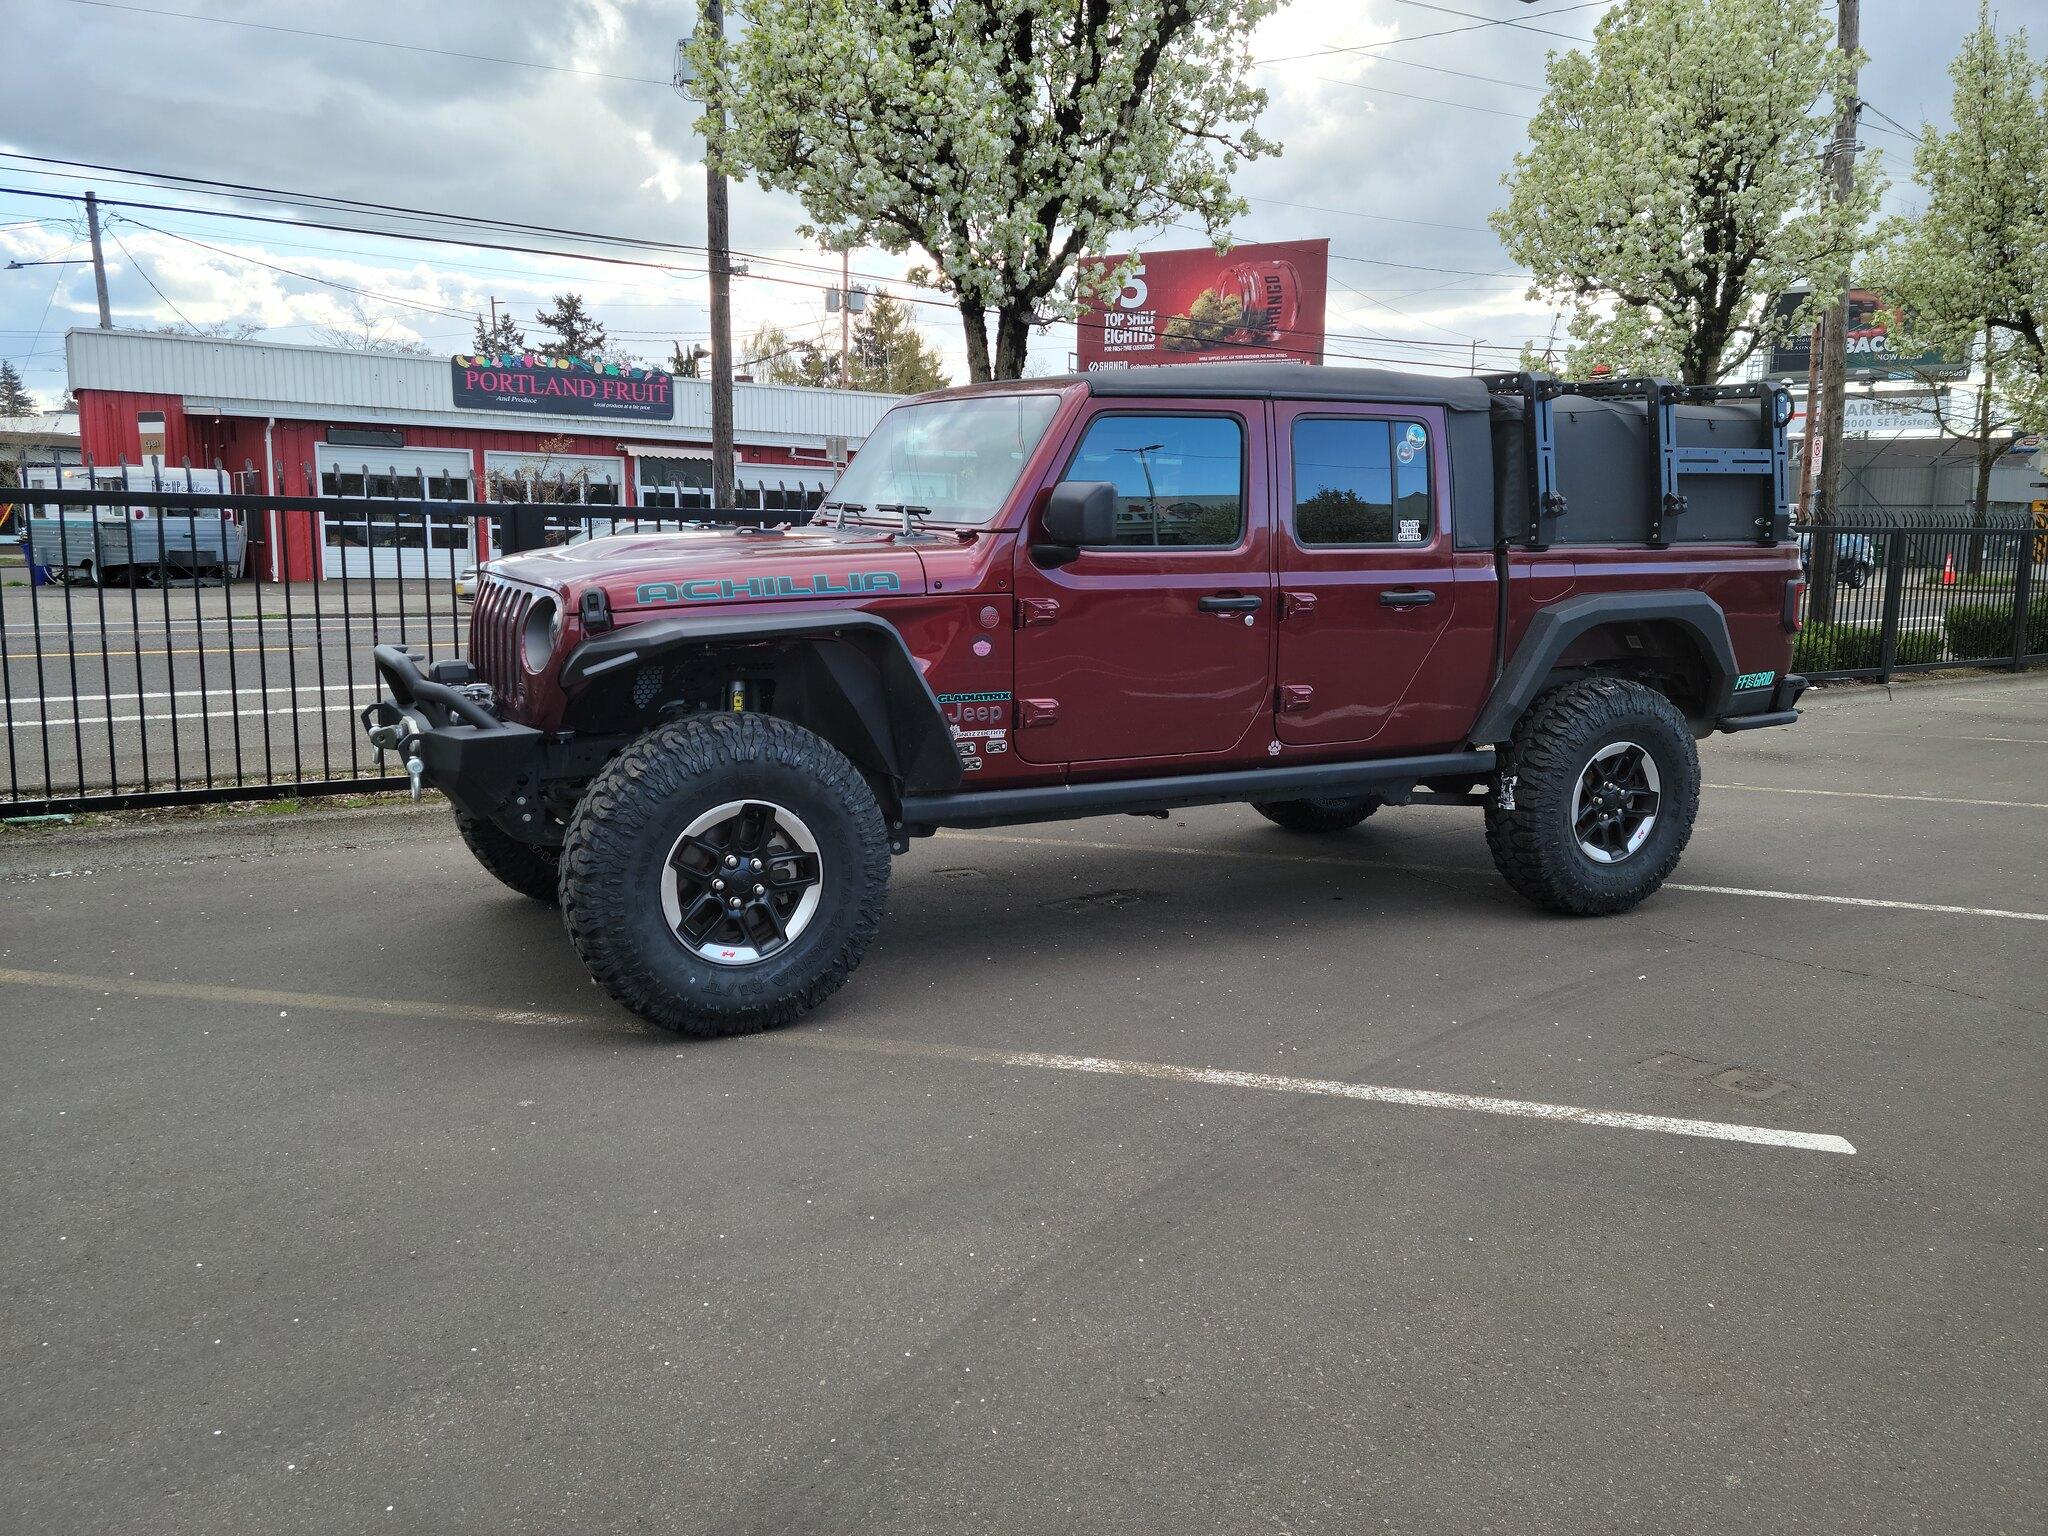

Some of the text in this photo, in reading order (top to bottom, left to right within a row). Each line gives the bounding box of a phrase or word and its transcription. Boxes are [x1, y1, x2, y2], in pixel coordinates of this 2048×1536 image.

[1104, 310, 1156, 327] TOP SHELF
[1104, 325, 1156, 345] EIGHTHS
[1878, 353, 1898, 361] NOW
[1099, 360, 1128, 371] SHANGO
[465, 370, 668, 403] PORTLAND FRUIT
[511, 396, 538, 404] Produce
[1844, 419, 1872, 428] 8000
[1877, 419, 1890, 427] SE
[1893, 418, 1929, 427] Foster
[181, 481, 211, 493] cffee
[636, 571, 900, 604] ACHILLIA
[937, 691, 1012, 704] GLADIATRIX
[948, 702, 1003, 724] Jeep
